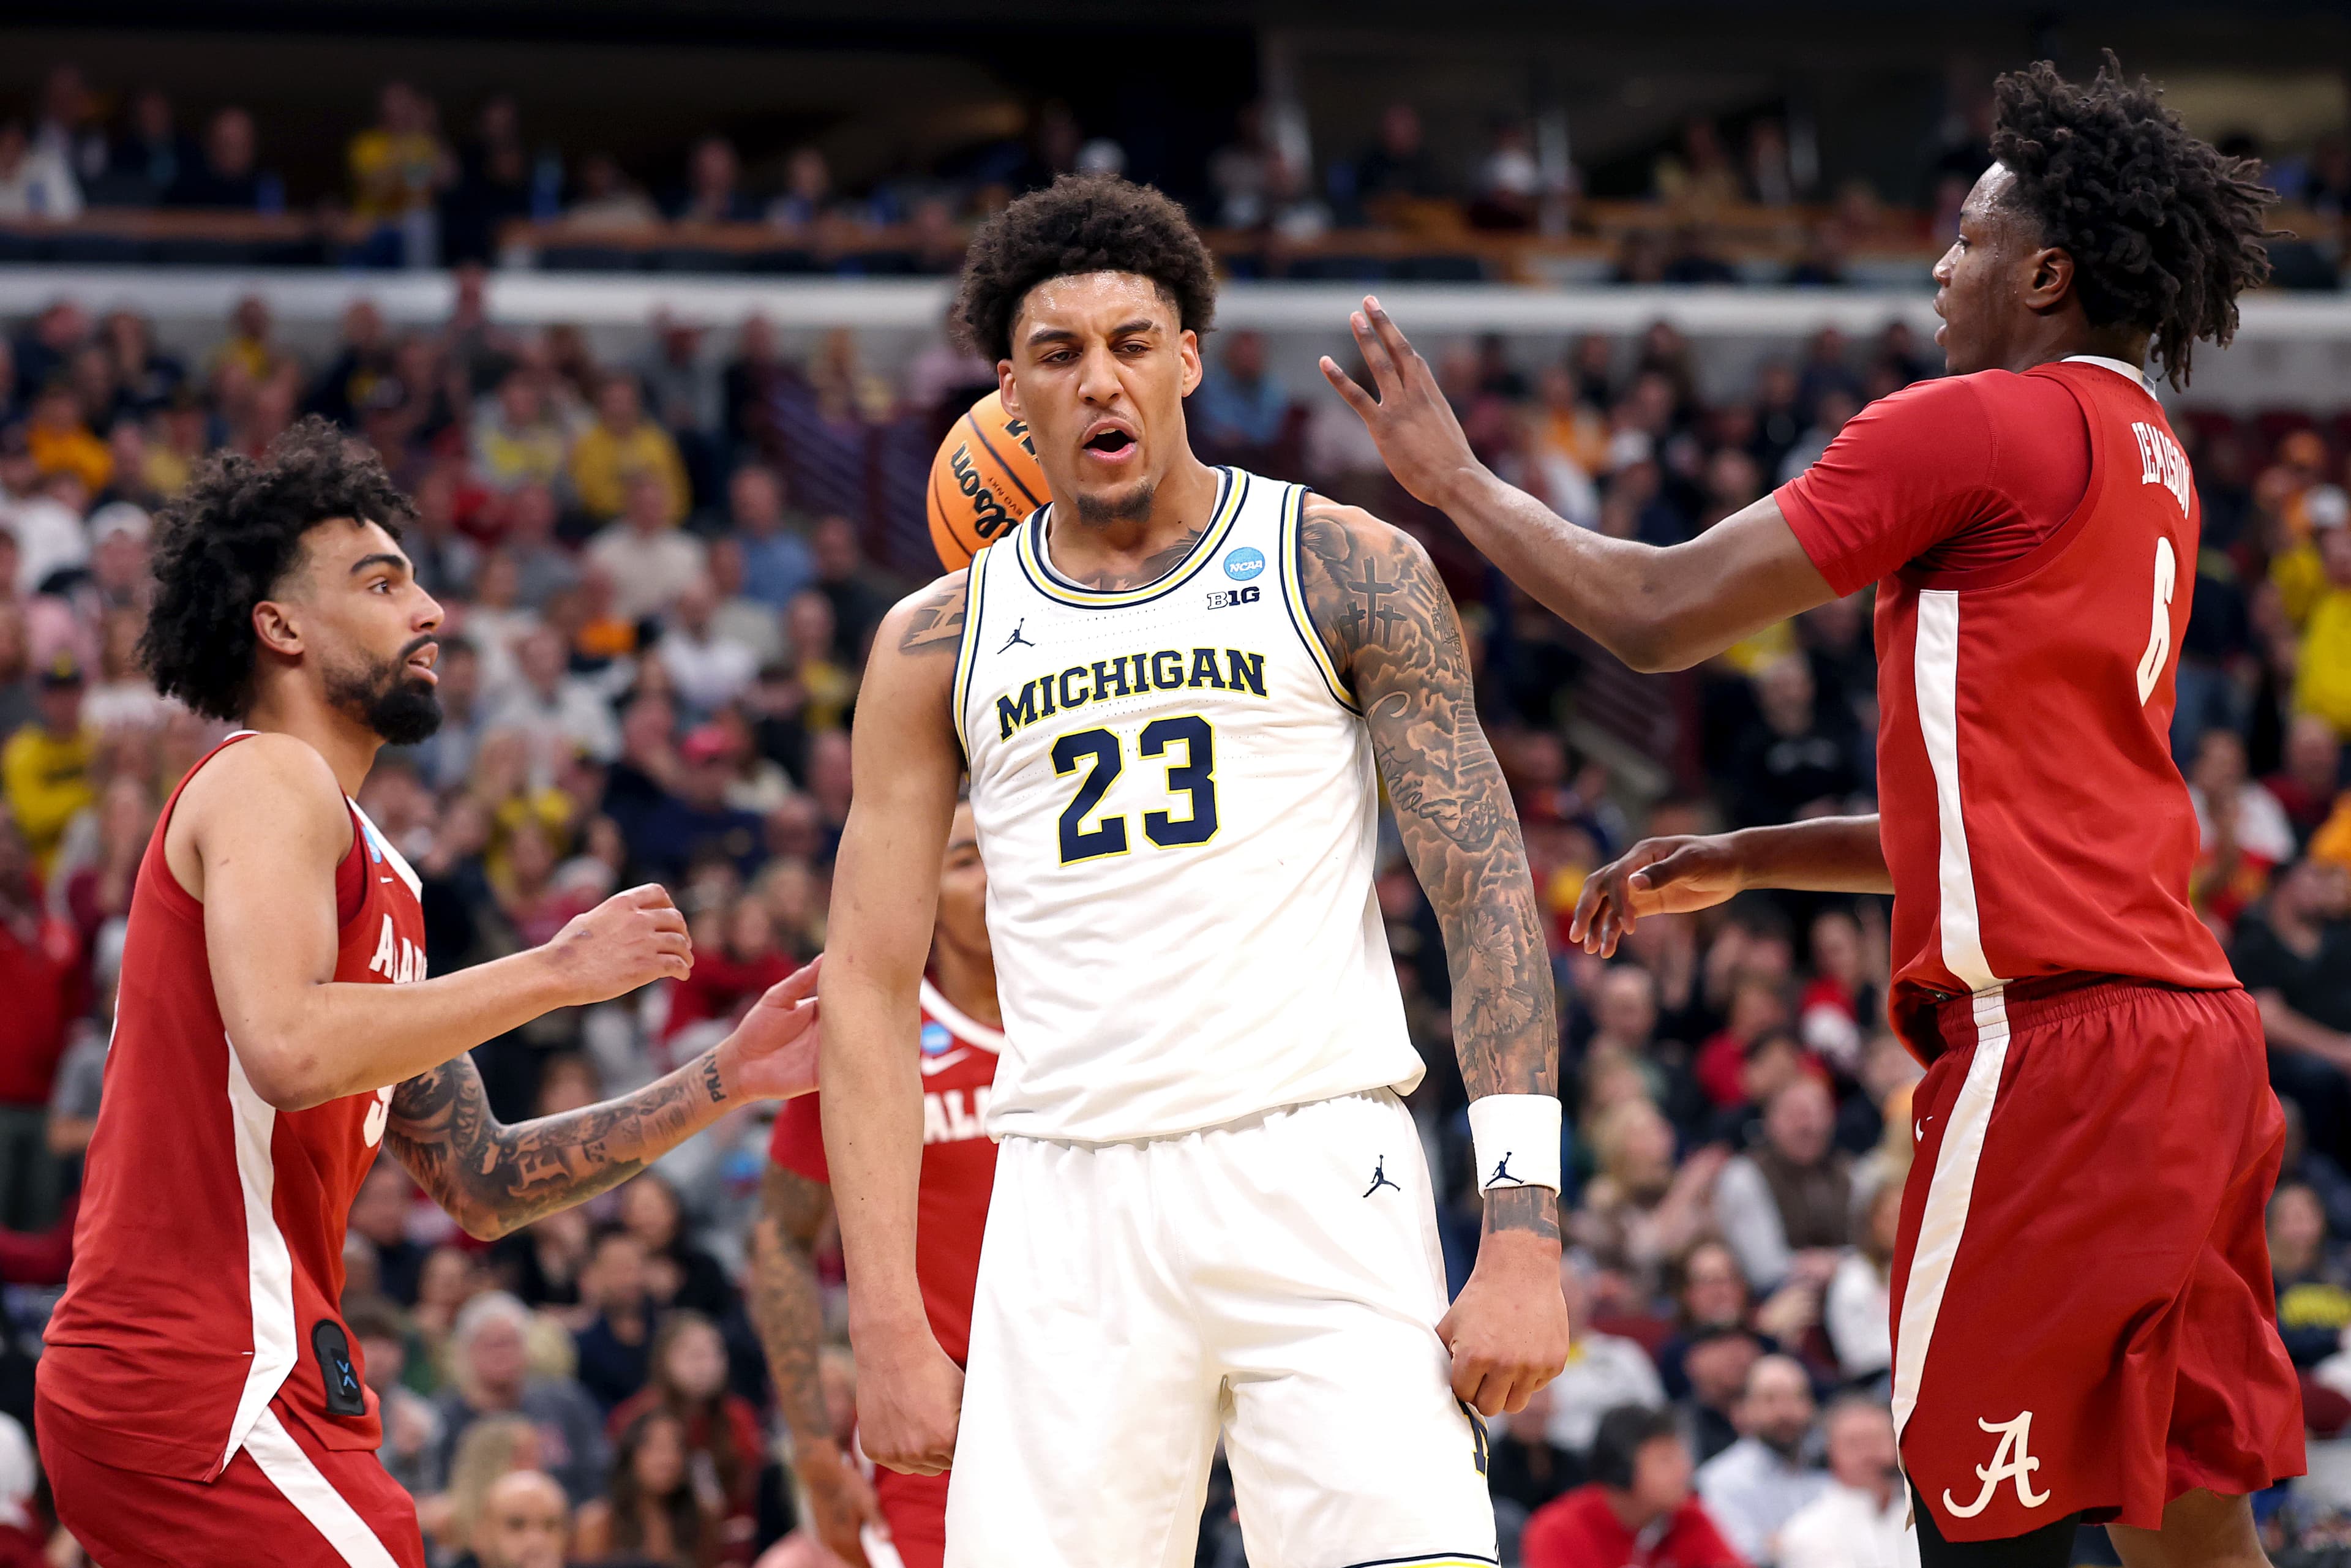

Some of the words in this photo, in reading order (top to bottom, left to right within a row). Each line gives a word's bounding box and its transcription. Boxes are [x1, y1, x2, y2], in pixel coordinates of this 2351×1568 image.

[2131, 422, 2189, 520] JEMISON
[1229, 560, 1262, 572] NCAA
[2136, 536, 2176, 708] 6
[996, 647, 1269, 743] MICHIGAN
[1048, 713, 1221, 868] 23
[702, 1054, 727, 1102] PRAY
[1943, 1410, 2050, 1518] A
